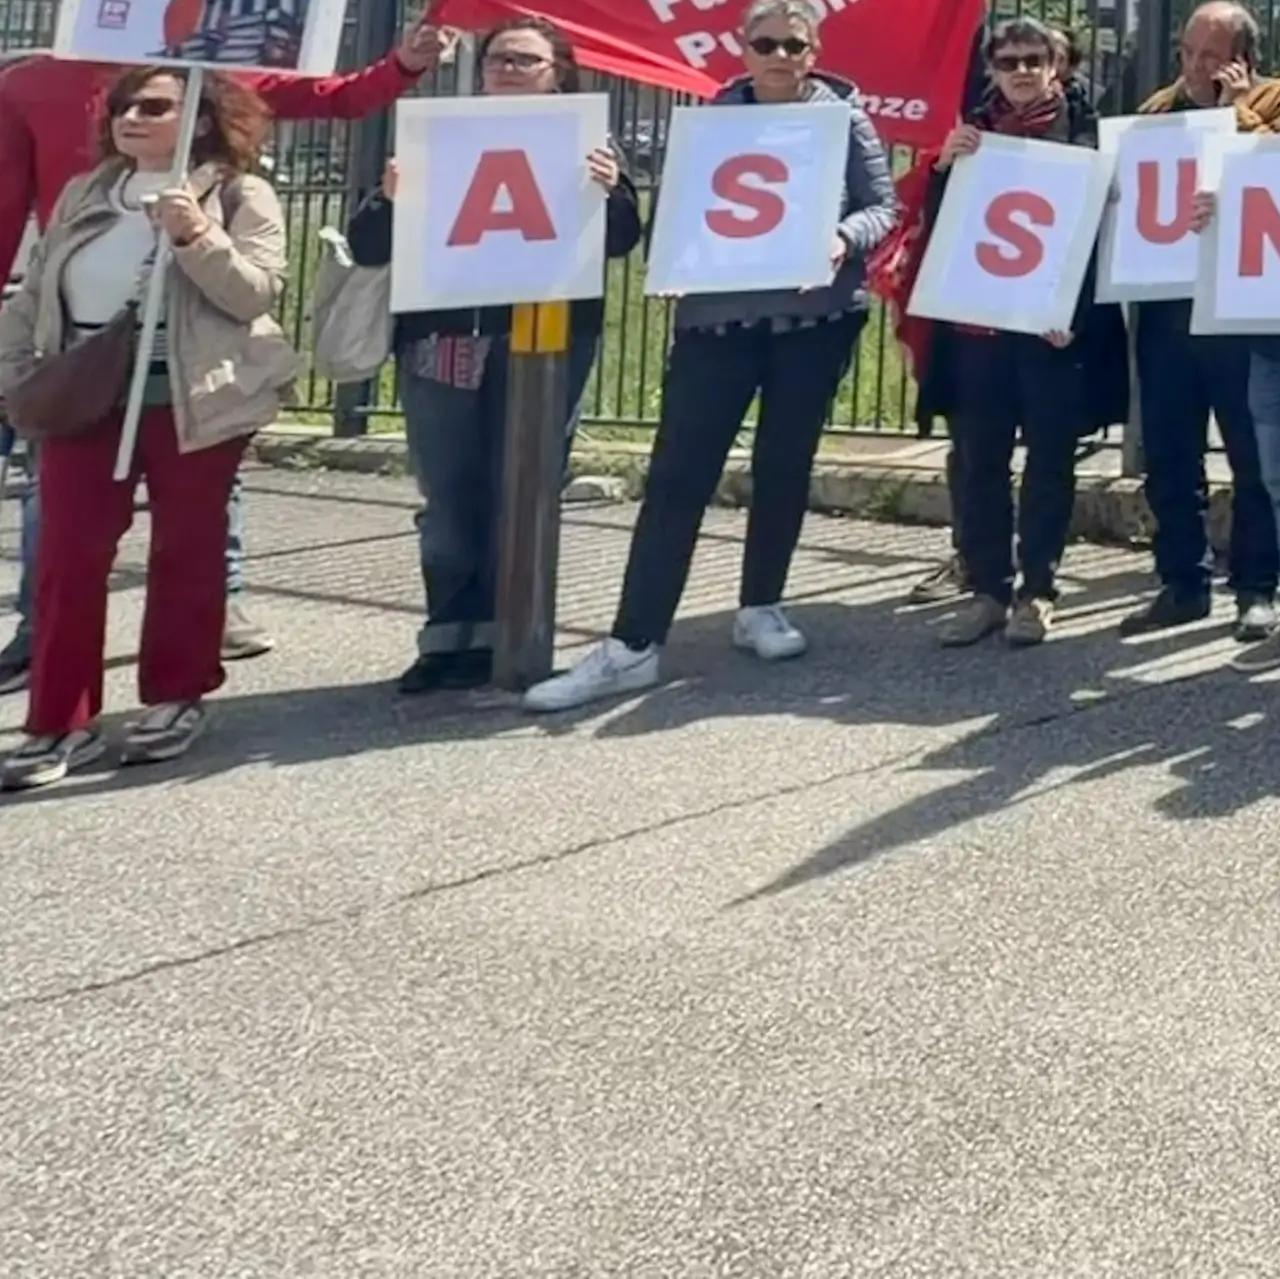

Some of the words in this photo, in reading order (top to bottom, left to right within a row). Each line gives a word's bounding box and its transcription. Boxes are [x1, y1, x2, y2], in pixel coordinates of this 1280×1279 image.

[447, 149, 556, 247] A
[705, 154, 789, 238] S
[975, 191, 1055, 277] S
[1136, 159, 1197, 244] U
